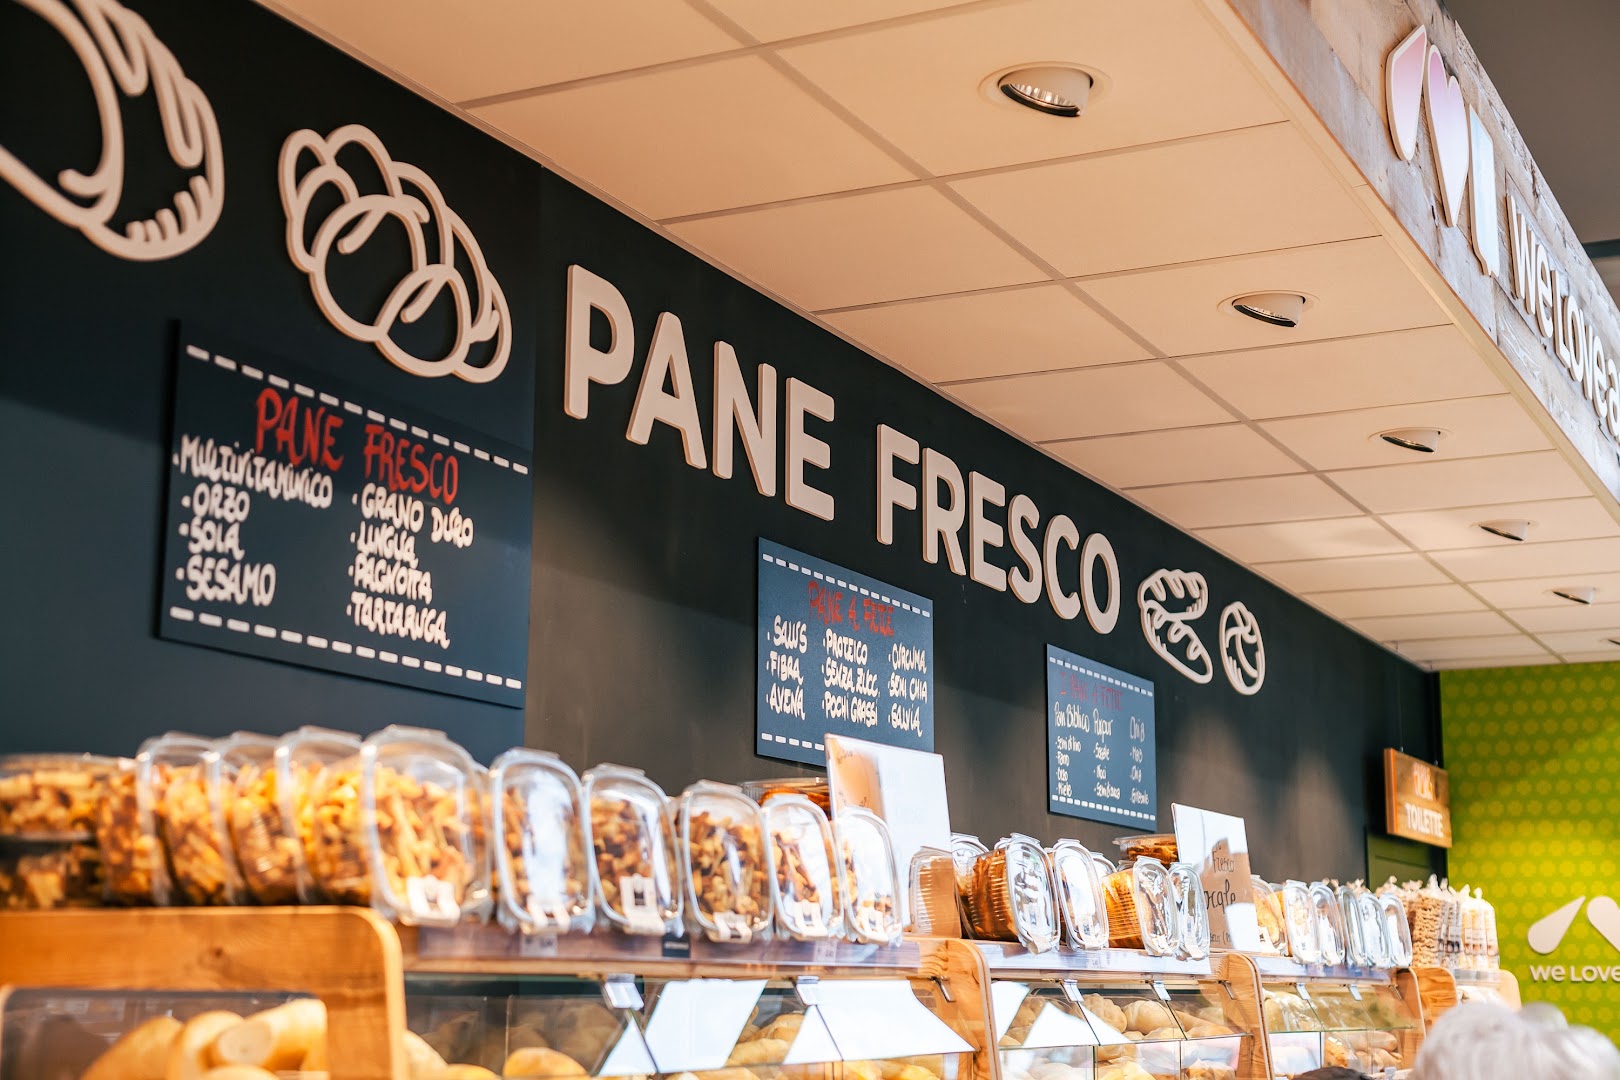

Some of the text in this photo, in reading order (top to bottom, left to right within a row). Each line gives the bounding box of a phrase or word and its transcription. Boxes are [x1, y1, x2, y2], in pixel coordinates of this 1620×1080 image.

[255, 387, 459, 505] PANE FRESCO
[564, 264, 1120, 634] PANE FRESCO
[192, 482, 251, 523] ORZO
[361, 482, 474, 548] GRANO DURO
[186, 553, 277, 606] SESAMO
[351, 591, 451, 649] TARTARUGA
[807, 580, 844, 626] PANE
[849, 594, 861, 632] A
[825, 628, 868, 666] PROTEICO
[770, 650, 804, 685] FIBRA
[824, 656, 856, 693] SENZA
[769, 682, 806, 721] AVENA
[824, 691, 878, 728] POCHI GRASSI
[909, 677, 928, 704] CHIA
[891, 702, 923, 738] SALVIA
[1405, 802, 1444, 838] TOILETTE
